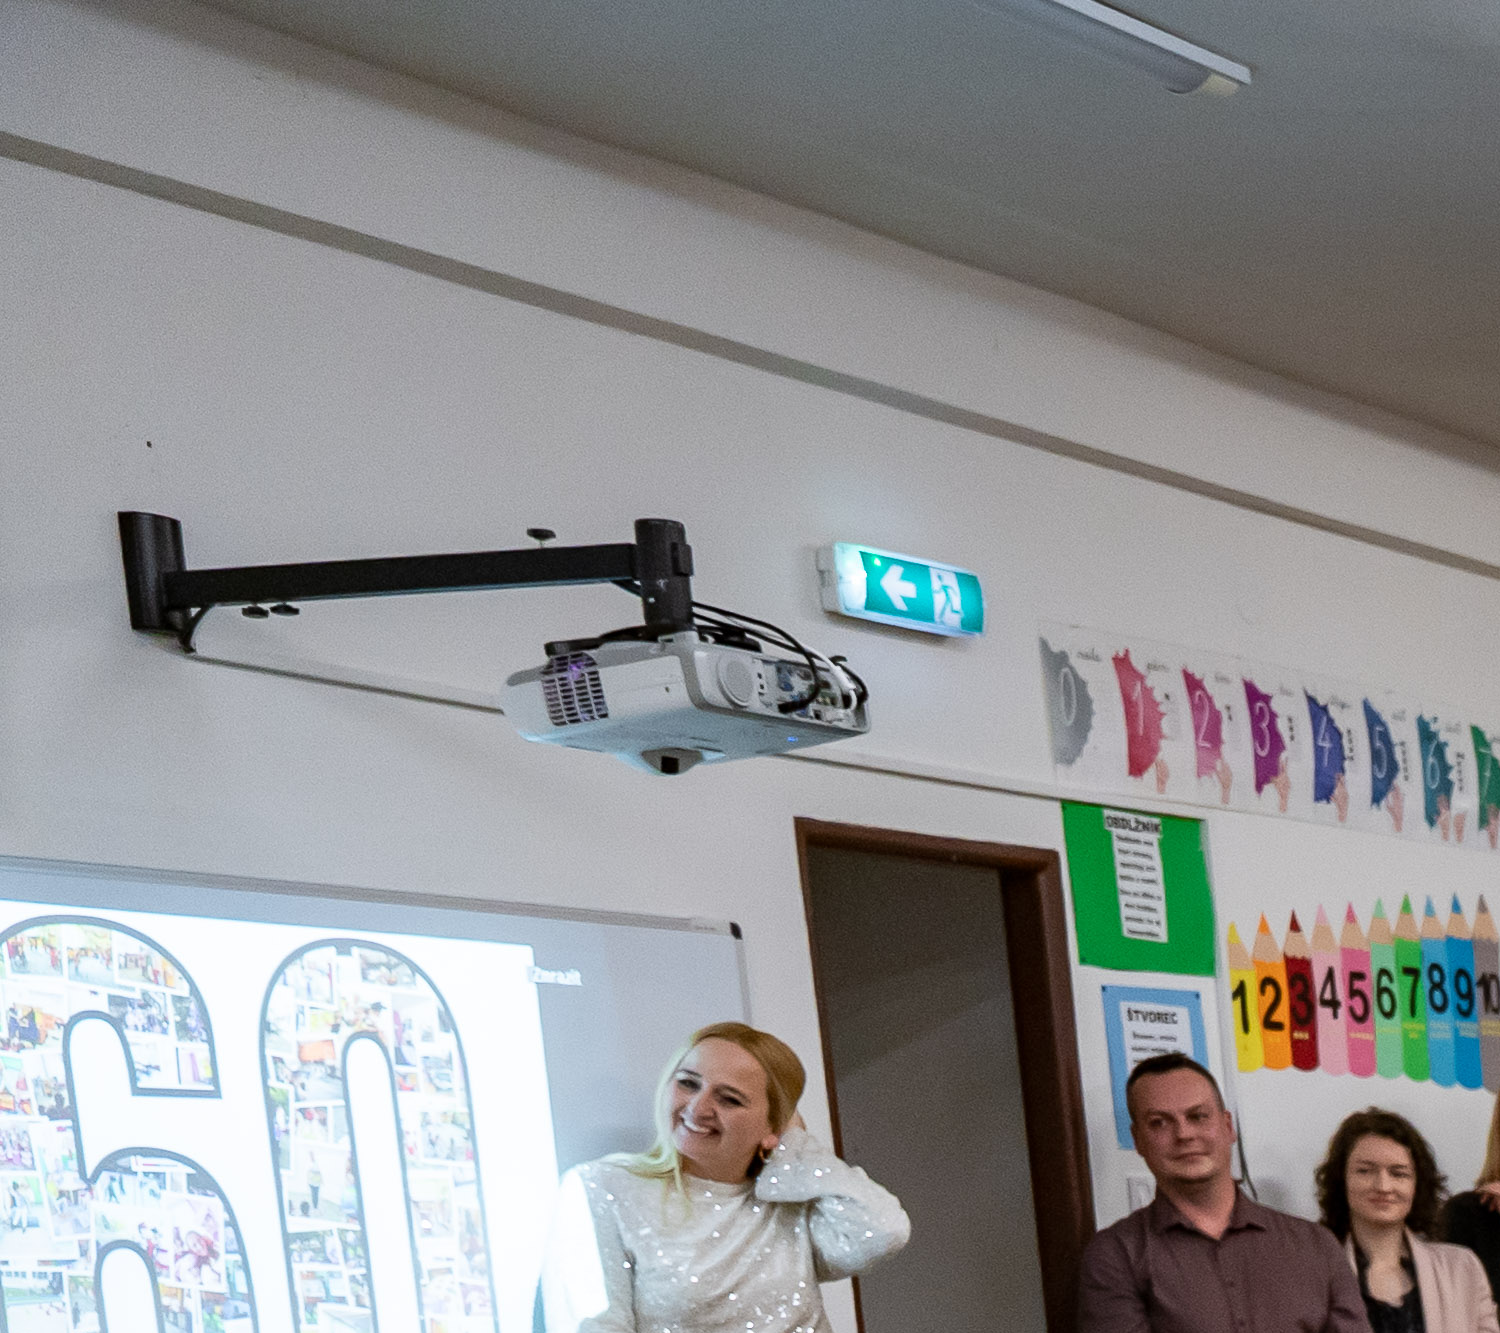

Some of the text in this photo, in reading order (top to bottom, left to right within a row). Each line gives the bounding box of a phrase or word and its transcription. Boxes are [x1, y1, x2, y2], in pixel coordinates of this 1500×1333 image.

[1132, 680, 1145, 737] 1
[1193, 690, 1211, 748] 2
[1255, 702, 1270, 757] 3
[1317, 715, 1332, 767] 4
[1373, 726, 1387, 779] 5
[1421, 739, 1440, 789] 6
[1232, 963, 1500, 1035] 1 2 3 4 5 6 7 8 9 10
